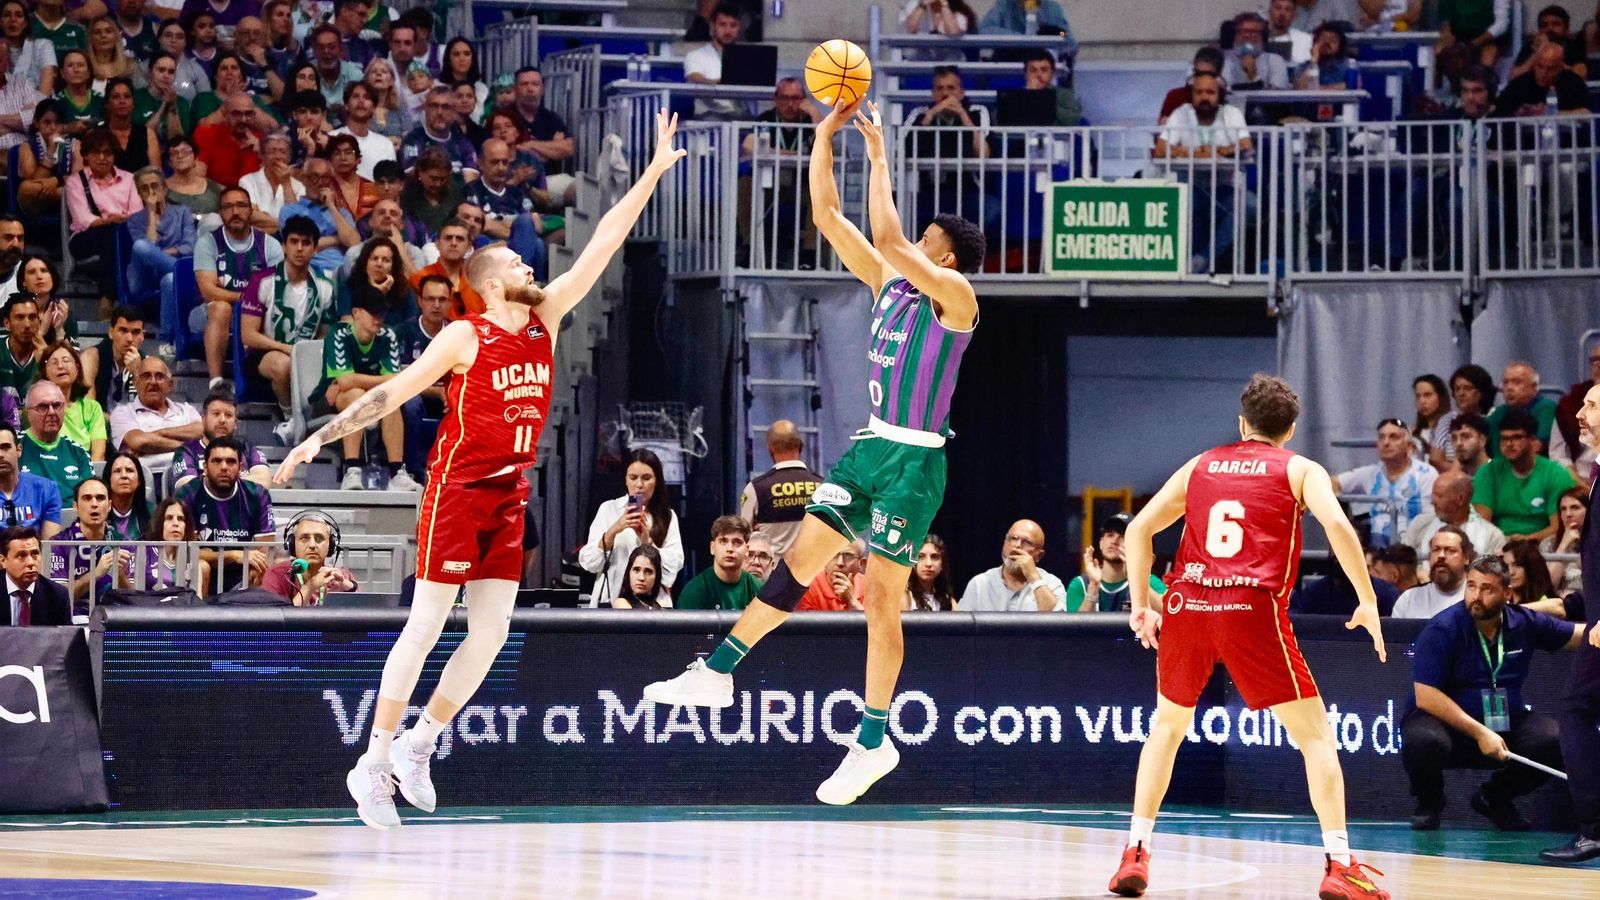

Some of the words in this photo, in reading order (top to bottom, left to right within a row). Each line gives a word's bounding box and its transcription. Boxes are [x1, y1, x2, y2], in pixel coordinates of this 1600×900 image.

[1063, 200, 1130, 227] SALIDA
[1144, 201, 1168, 228] DE
[1055, 233, 1175, 261] EMERGENCIA
[492, 362, 550, 391] UCAM
[503, 385, 544, 401] MURCIA
[513, 425, 533, 453] 11
[1207, 459, 1267, 475] GARCÍA
[770, 482, 819, 497] COFE
[772, 497, 811, 508] SEGURI
[213, 528, 249, 537] Fundación
[871, 520, 886, 534] aga
[1205, 500, 1246, 558] 6
[1223, 603, 1253, 611] MURCIA
[543, 705, 586, 745] a
[597, 688, 939, 746] MAURICO
[953, 705, 1062, 746] con
[1075, 705, 1231, 746] vuo
[1238, 703, 1364, 753] dirto
[1371, 699, 1402, 755] d
